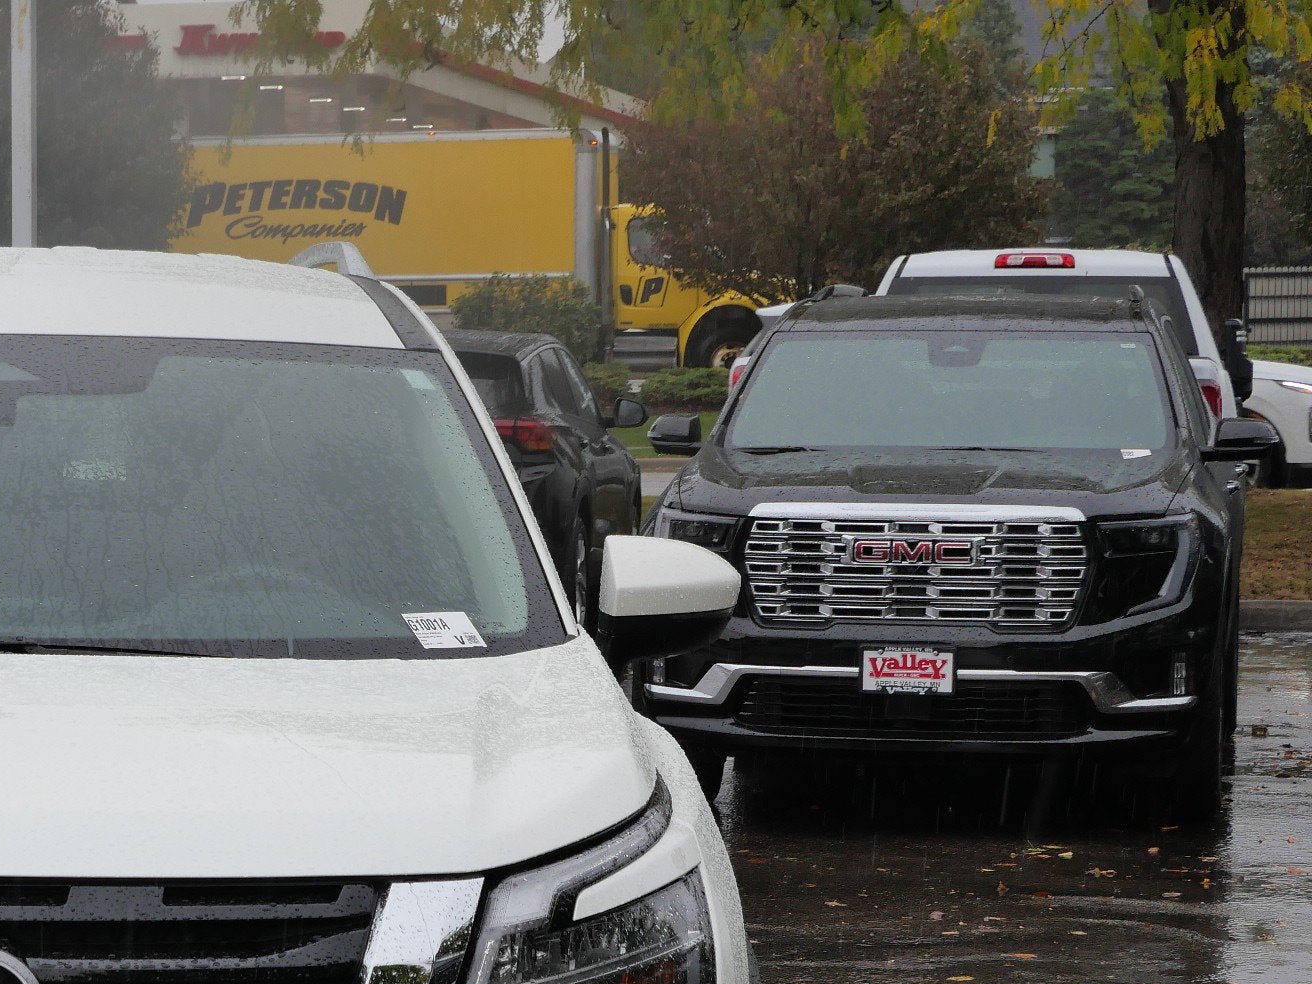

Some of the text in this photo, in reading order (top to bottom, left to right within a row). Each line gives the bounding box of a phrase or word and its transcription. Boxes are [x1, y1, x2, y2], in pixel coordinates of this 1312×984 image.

[187, 179, 408, 229] PETERSON
[225, 214, 367, 245] Companies
[639, 276, 665, 305] P
[854, 540, 971, 564] GMC
